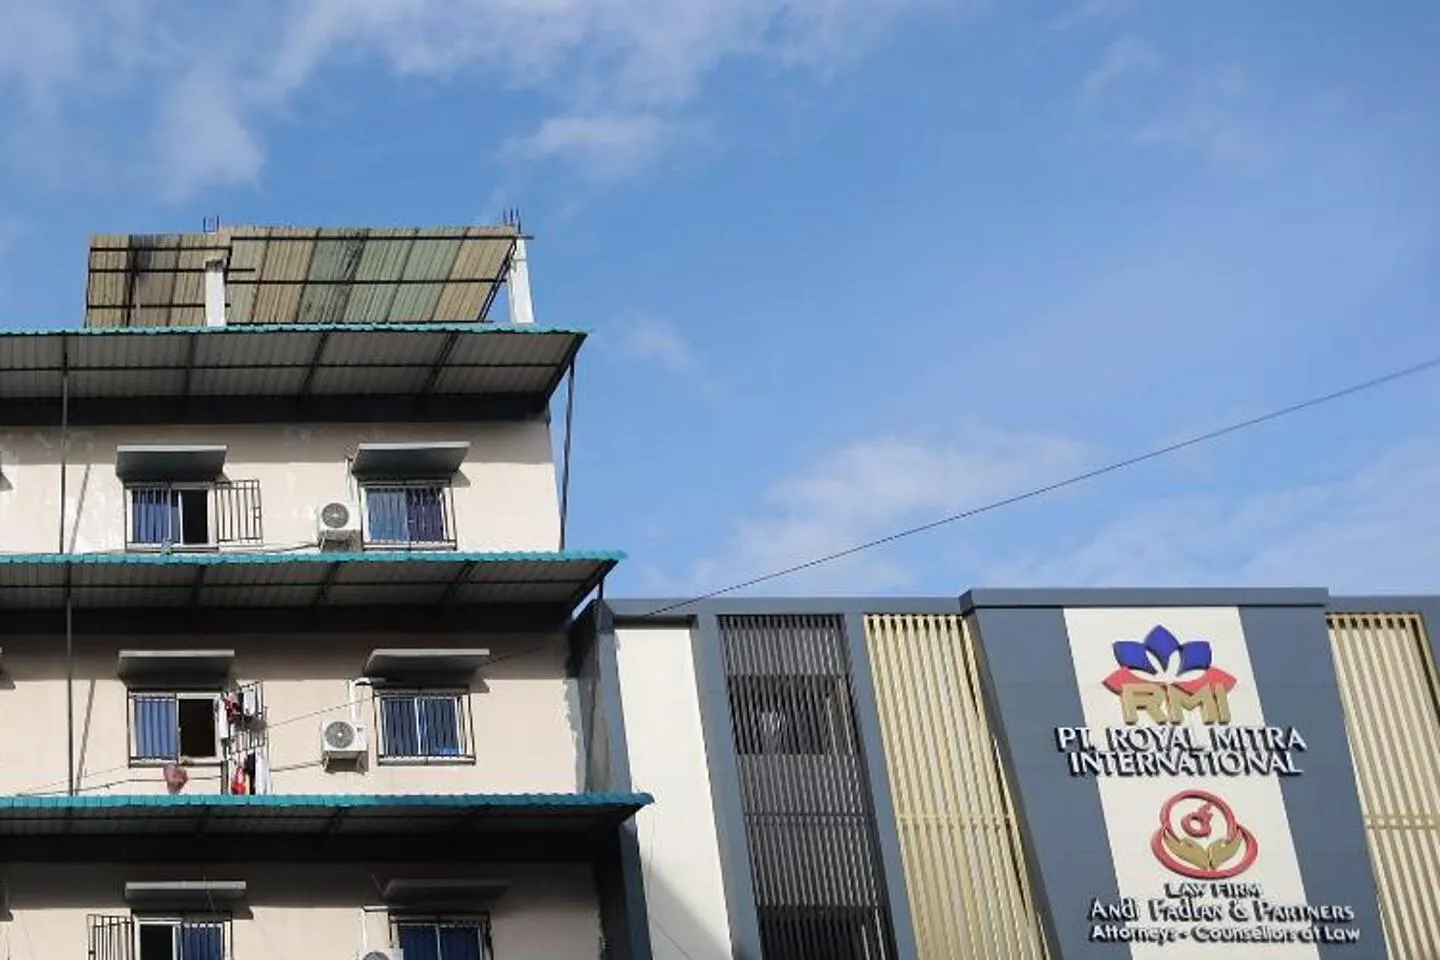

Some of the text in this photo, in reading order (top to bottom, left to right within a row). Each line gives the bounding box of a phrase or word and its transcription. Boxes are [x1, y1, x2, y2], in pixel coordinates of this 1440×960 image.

[1121, 682, 1232, 725] RMI
[1110, 726, 1204, 752] ROYAL
[1209, 726, 1308, 752] MITRA
[1068, 751, 1305, 777] INTERNATIONAL
[1323, 925, 1361, 944] Law
